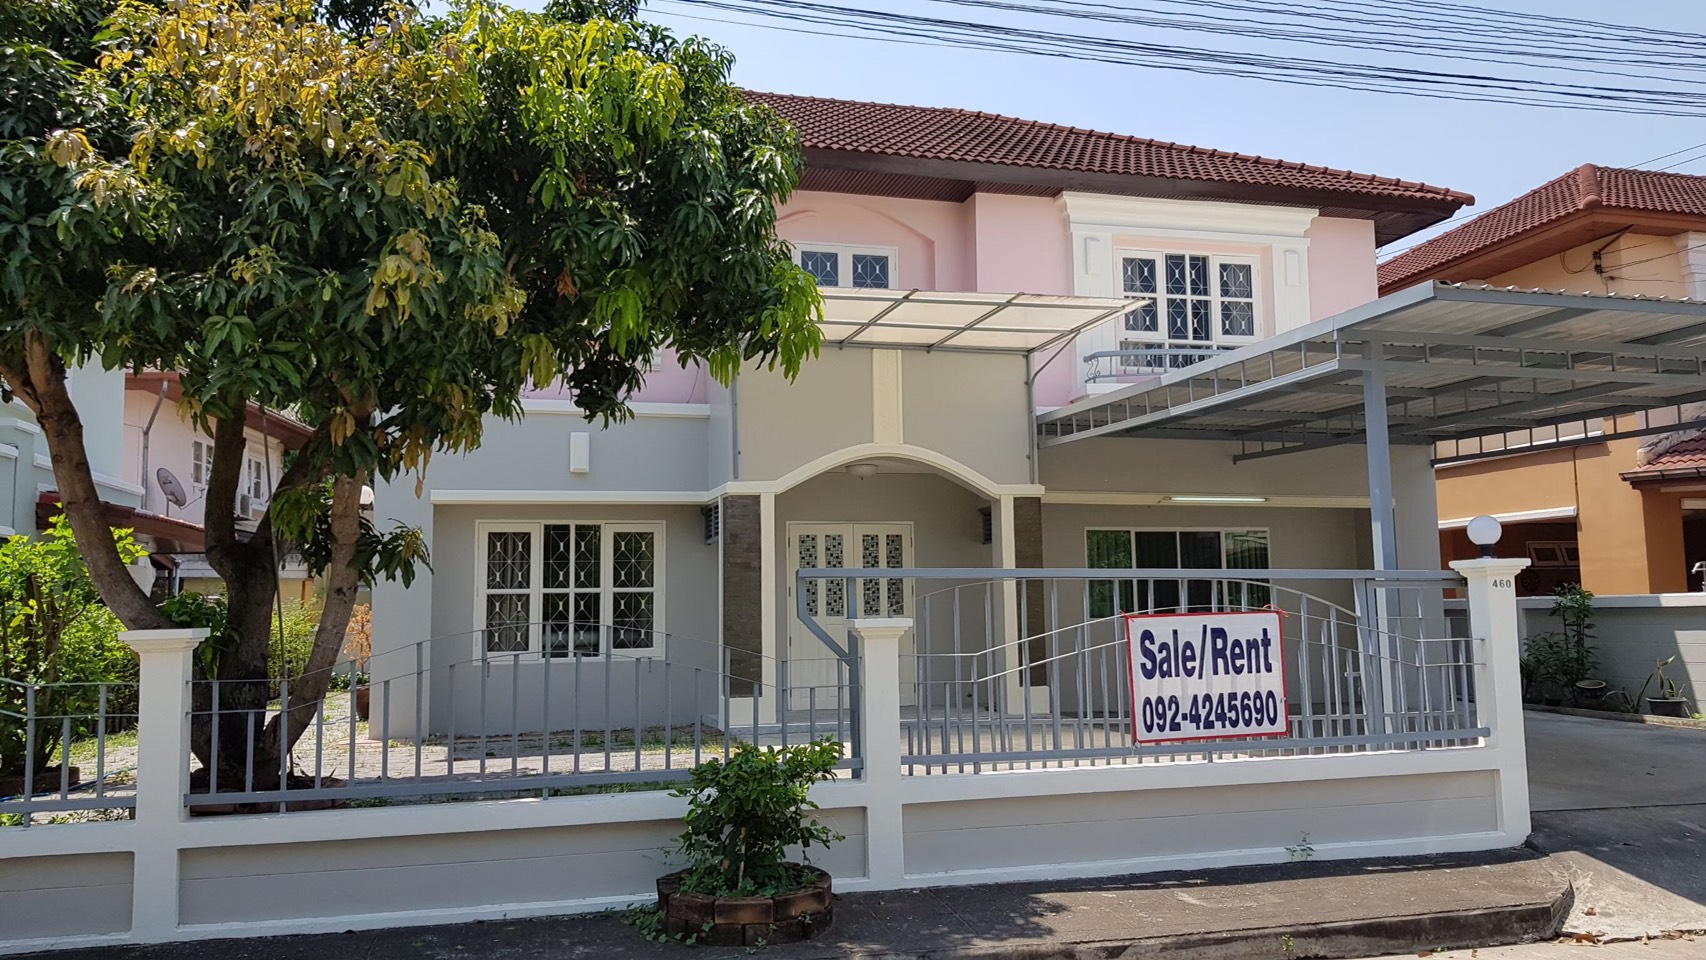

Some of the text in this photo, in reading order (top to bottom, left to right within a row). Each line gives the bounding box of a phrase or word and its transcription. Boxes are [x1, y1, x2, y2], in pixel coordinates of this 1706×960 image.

[1492, 579, 1512, 588] 460
[1140, 624, 1272, 680] Sale/Rent
[1142, 690, 1278, 733] 092-4245690
